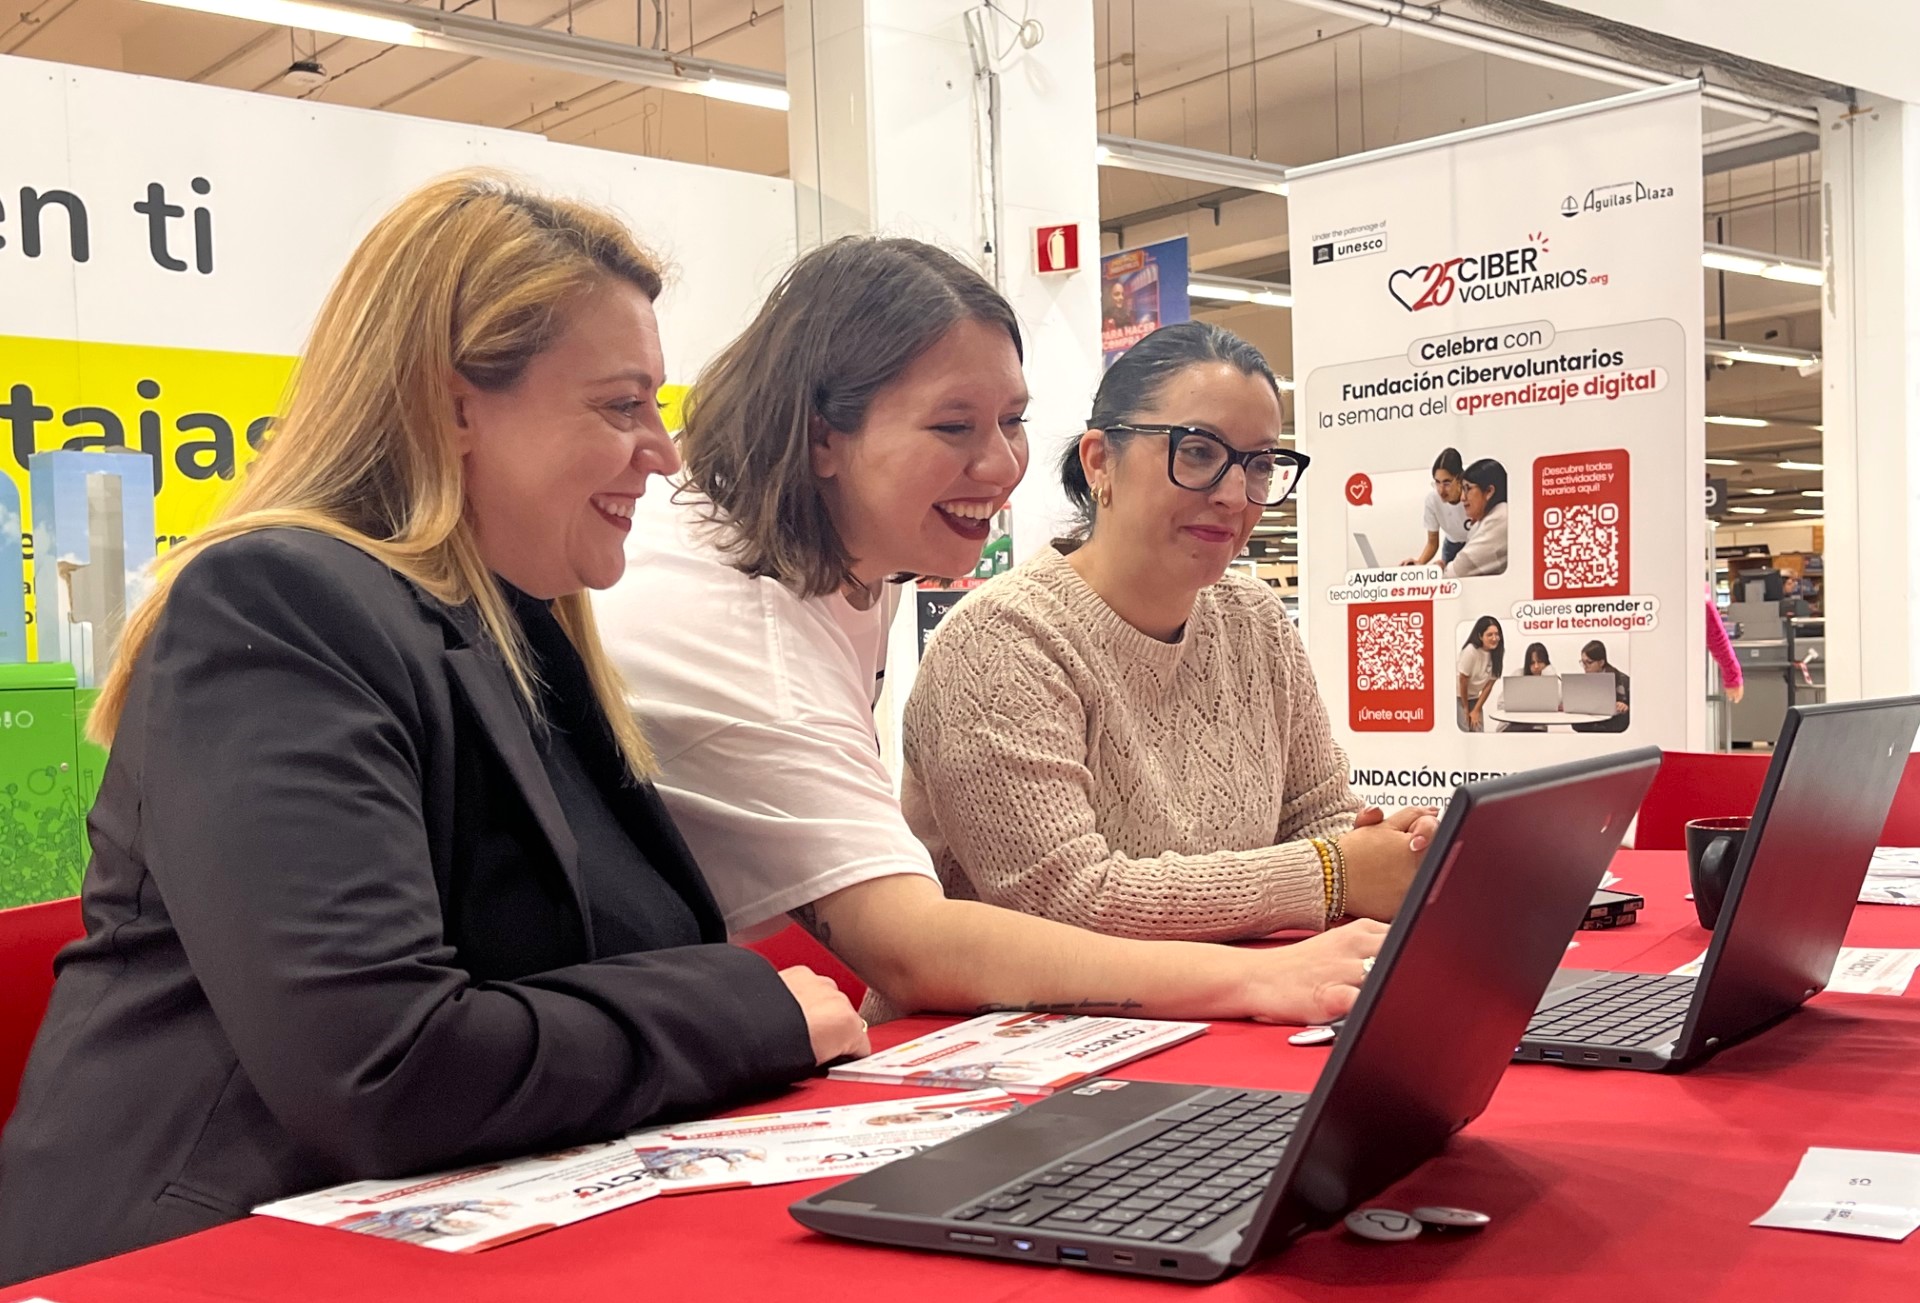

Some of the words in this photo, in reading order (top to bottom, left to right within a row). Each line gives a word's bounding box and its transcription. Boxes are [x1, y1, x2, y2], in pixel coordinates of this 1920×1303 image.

[1635, 181, 1674, 203] Plaza
[0, 186, 90, 263] n
[133, 176, 214, 274] ti
[1338, 239, 1383, 256] unesco
[1458, 247, 1538, 283] CIBER
[1420, 334, 1498, 360] Celebra
[1503, 328, 1542, 349] con
[1342, 371, 1444, 402] Fundación
[1446, 348, 1624, 387] Cibervoluntarios
[1319, 411, 1334, 429] la
[1337, 399, 1414, 426] semana
[1419, 395, 1447, 416] del
[1455, 379, 1580, 416] aprendizaje
[1583, 368, 1656, 400] digital
[1542, 464, 1585, 477] ¡Descubre
[1586, 462, 1613, 472] todas
[1542, 477, 1554, 486] las
[1555, 473, 1607, 485] actividades
[1608, 473, 1615, 483] y
[1542, 484, 1577, 496] horarios
[1347, 571, 1398, 587] ¿Ayudar
[1400, 572, 1424, 582] con
[1426, 568, 1438, 580] la
[1329, 586, 1389, 602] tecnología
[1390, 587, 1405, 598] es
[1407, 586, 1438, 599] muy
[1439, 582, 1458, 595] tú?
[1516, 603, 1572, 619] ¿Quieres
[1575, 600, 1641, 618] aprender
[1643, 601, 1653, 611] a
[1523, 620, 1554, 631] usar
[1556, 617, 1569, 629] la
[1571, 613, 1653, 631] tecnología?
[1358, 706, 1393, 722] ¡Únete
[1394, 707, 1424, 723] aquí!
[1349, 765, 1447, 788] UNDACIÓN
[1399, 795, 1408, 806] a
